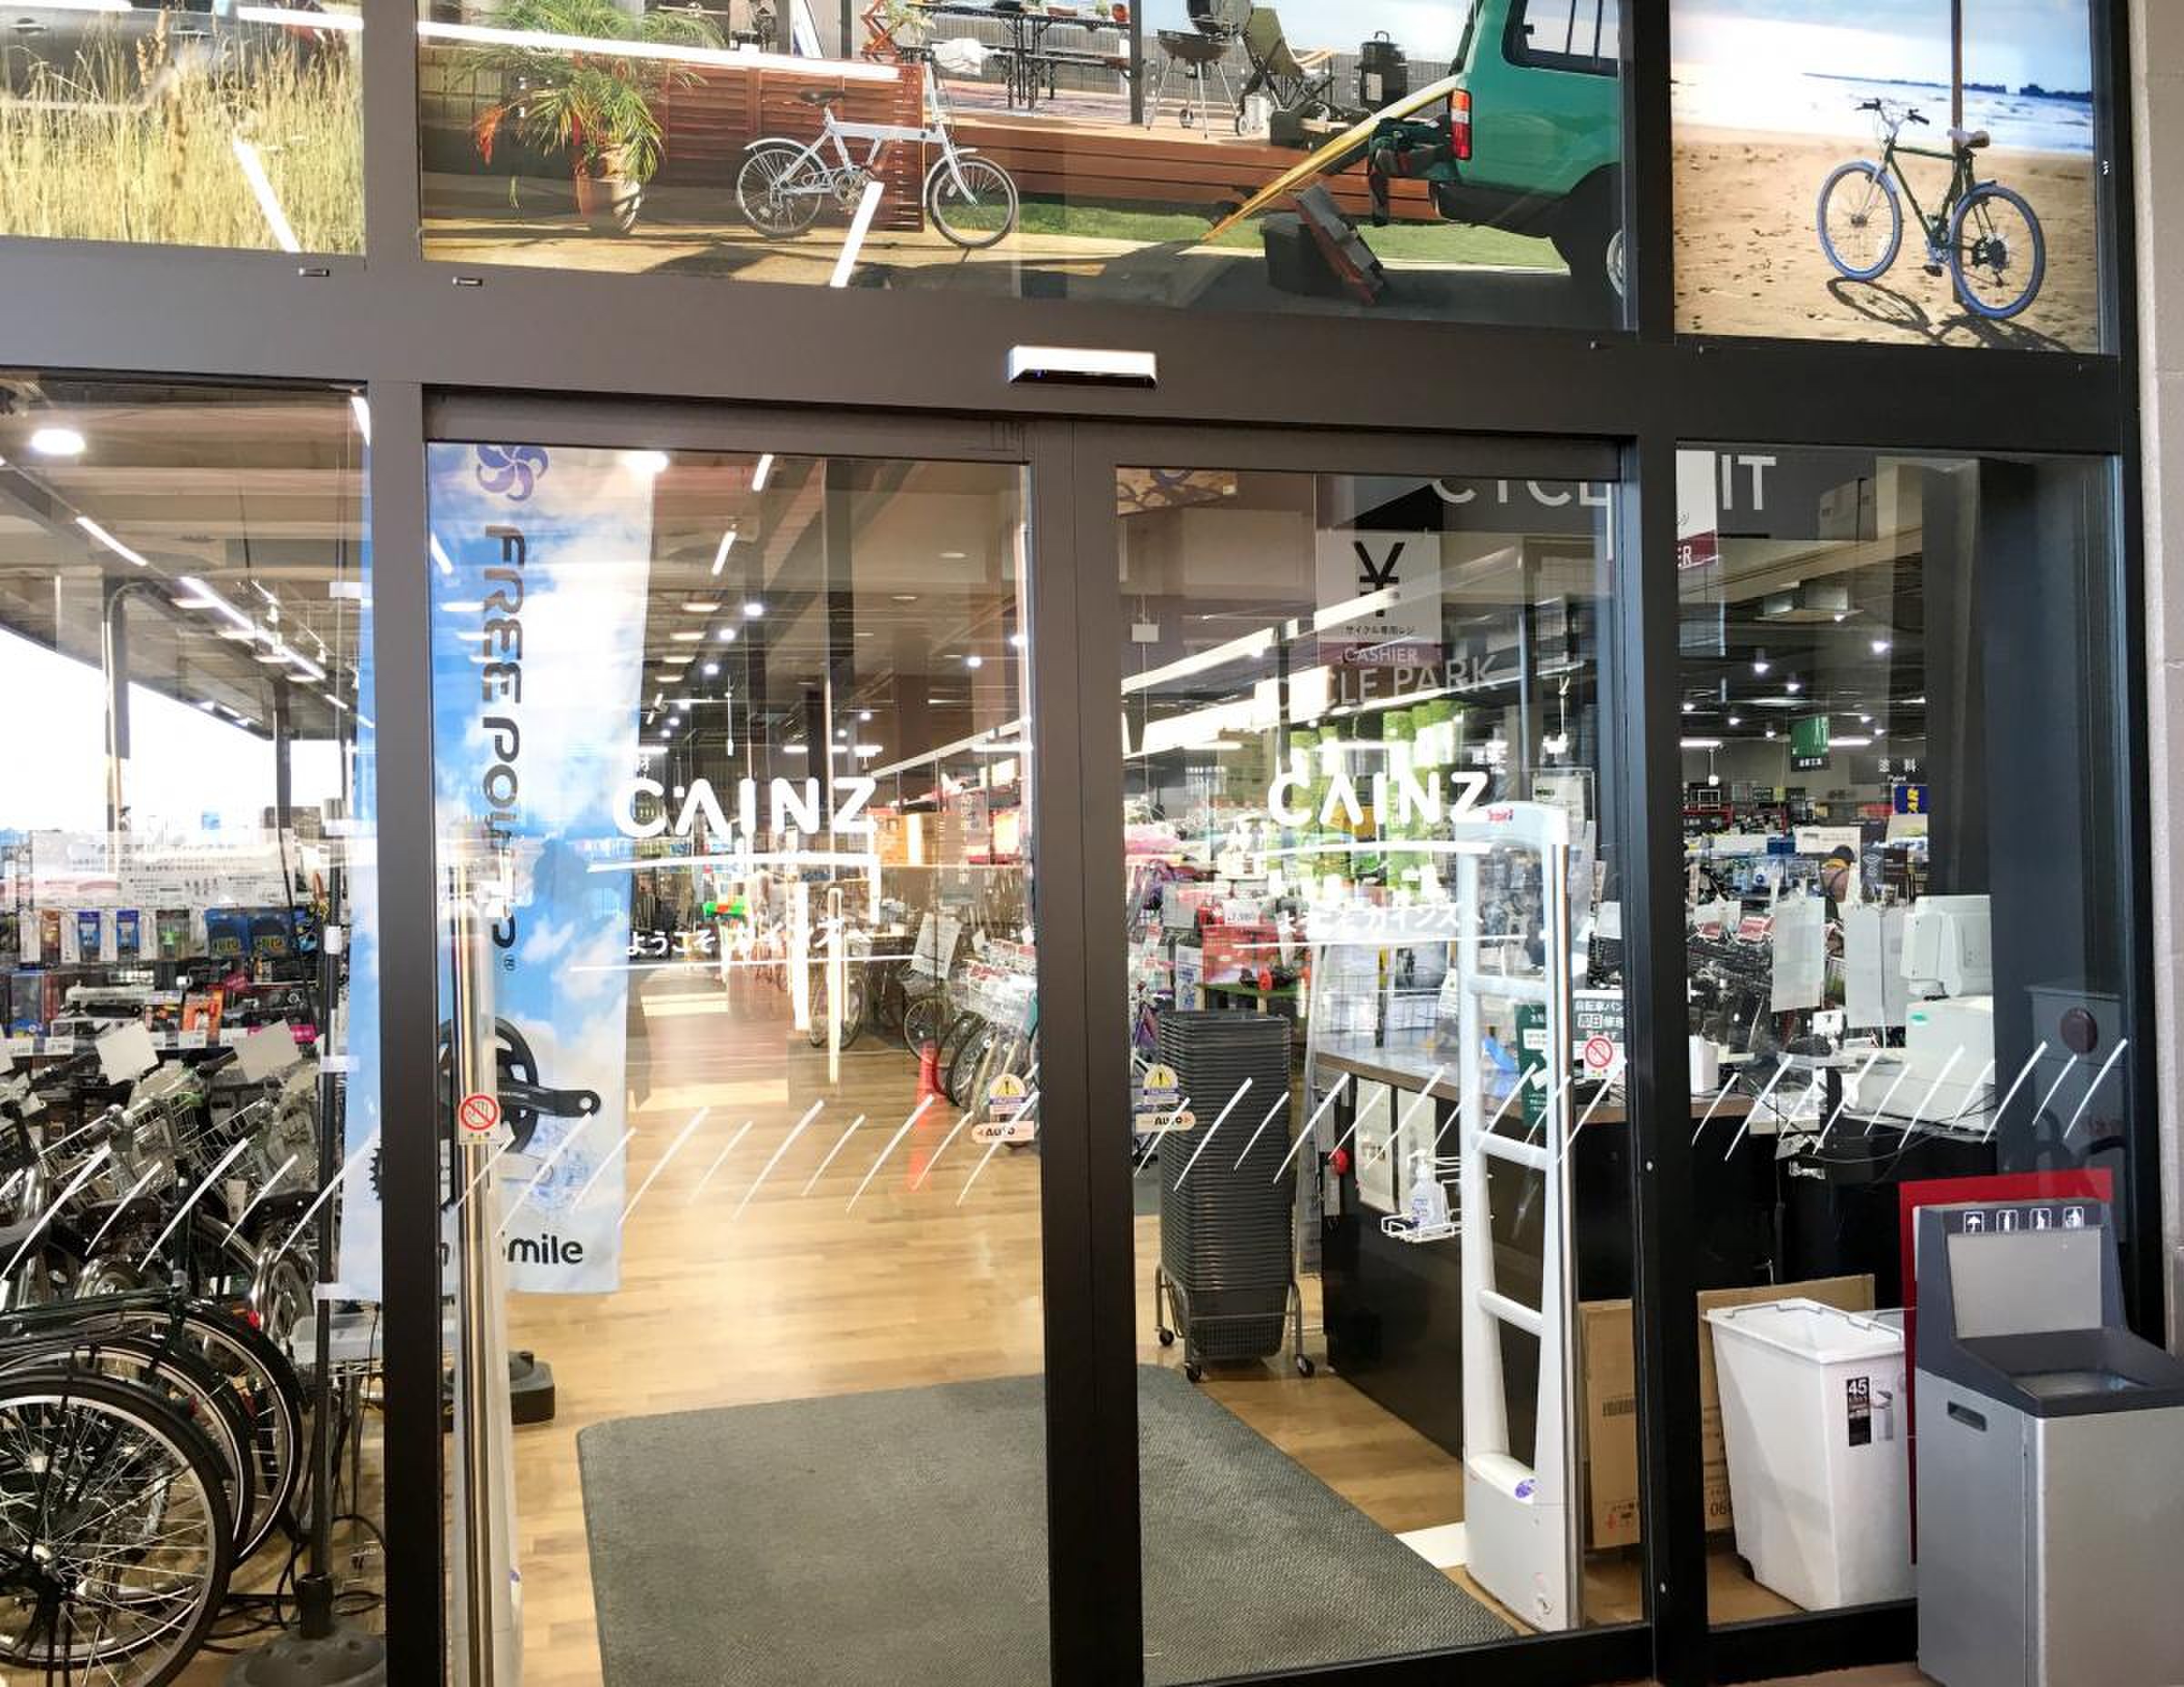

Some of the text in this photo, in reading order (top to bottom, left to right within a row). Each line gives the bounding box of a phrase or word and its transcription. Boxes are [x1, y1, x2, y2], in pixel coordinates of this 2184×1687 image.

[483, 525, 525, 704] FREE
[1344, 647, 1418, 666] CASHIER
[1394, 656, 1501, 697] PARK
[612, 778, 876, 838] CAINZ
[1268, 771, 1489, 826] CAINZ
[501, 1232, 583, 1265] mile
[1848, 1379, 1867, 1396] 45
